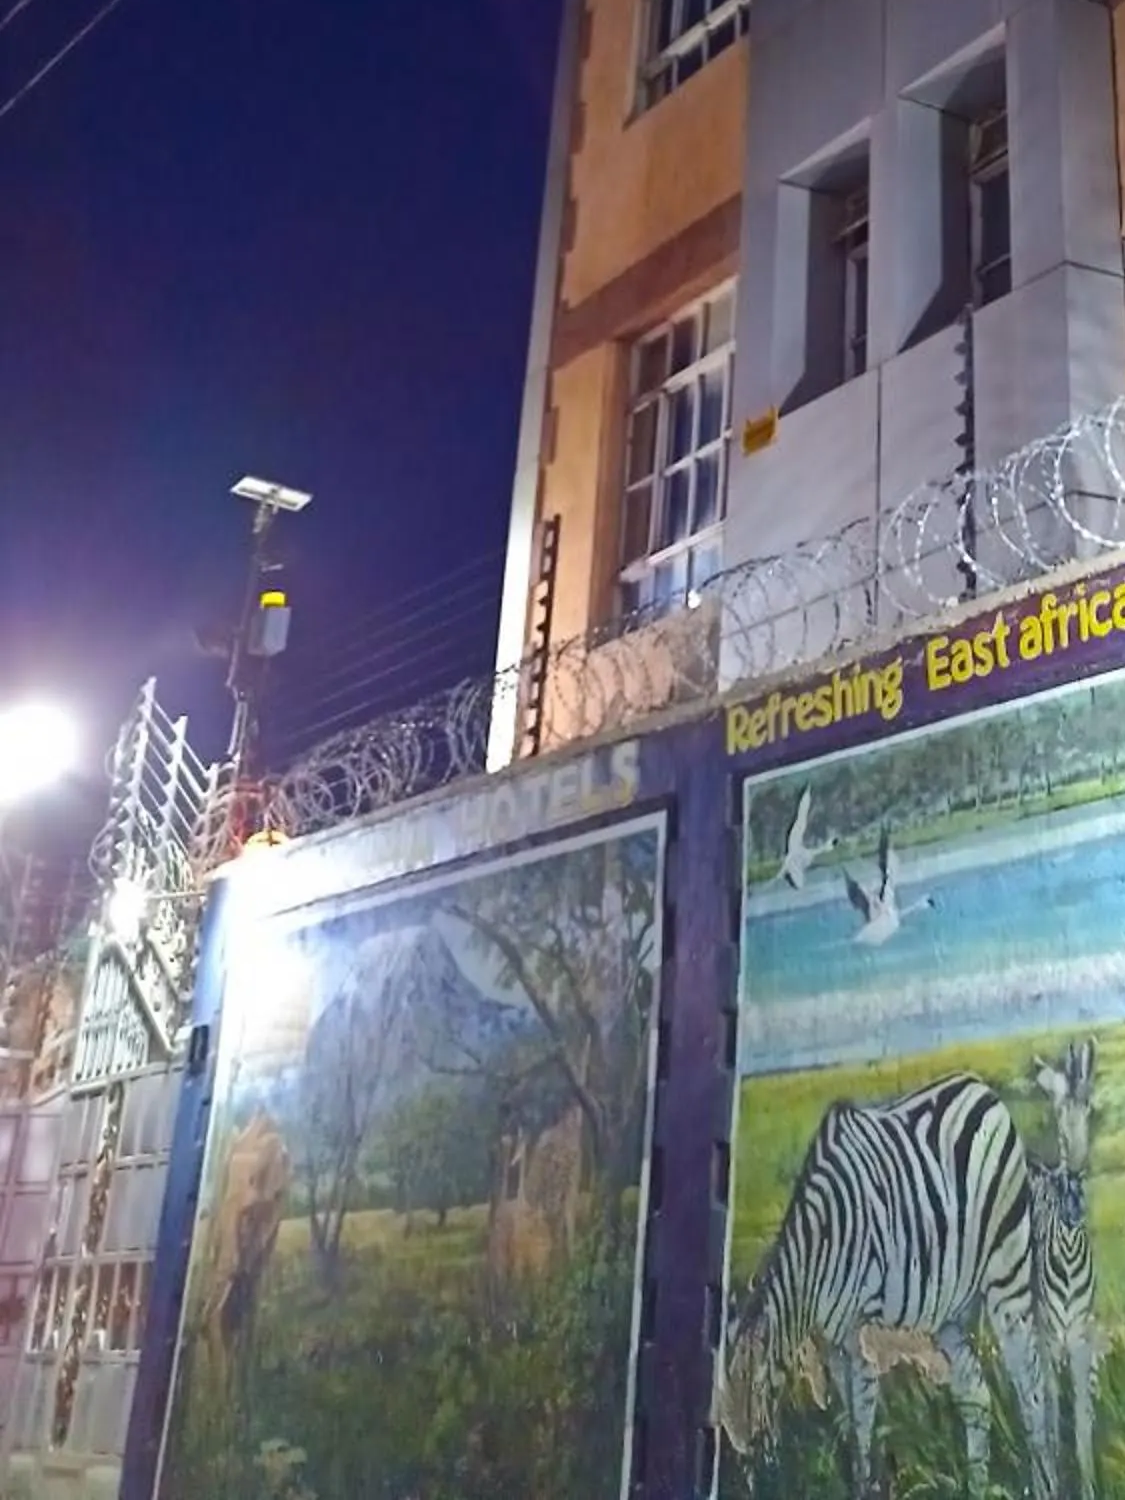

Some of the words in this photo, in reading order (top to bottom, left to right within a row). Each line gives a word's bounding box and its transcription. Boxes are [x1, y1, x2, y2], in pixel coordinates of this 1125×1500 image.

[726, 657, 903, 756] Refreshing
[926, 611, 1010, 691] East
[460, 740, 641, 847] HOTELS
